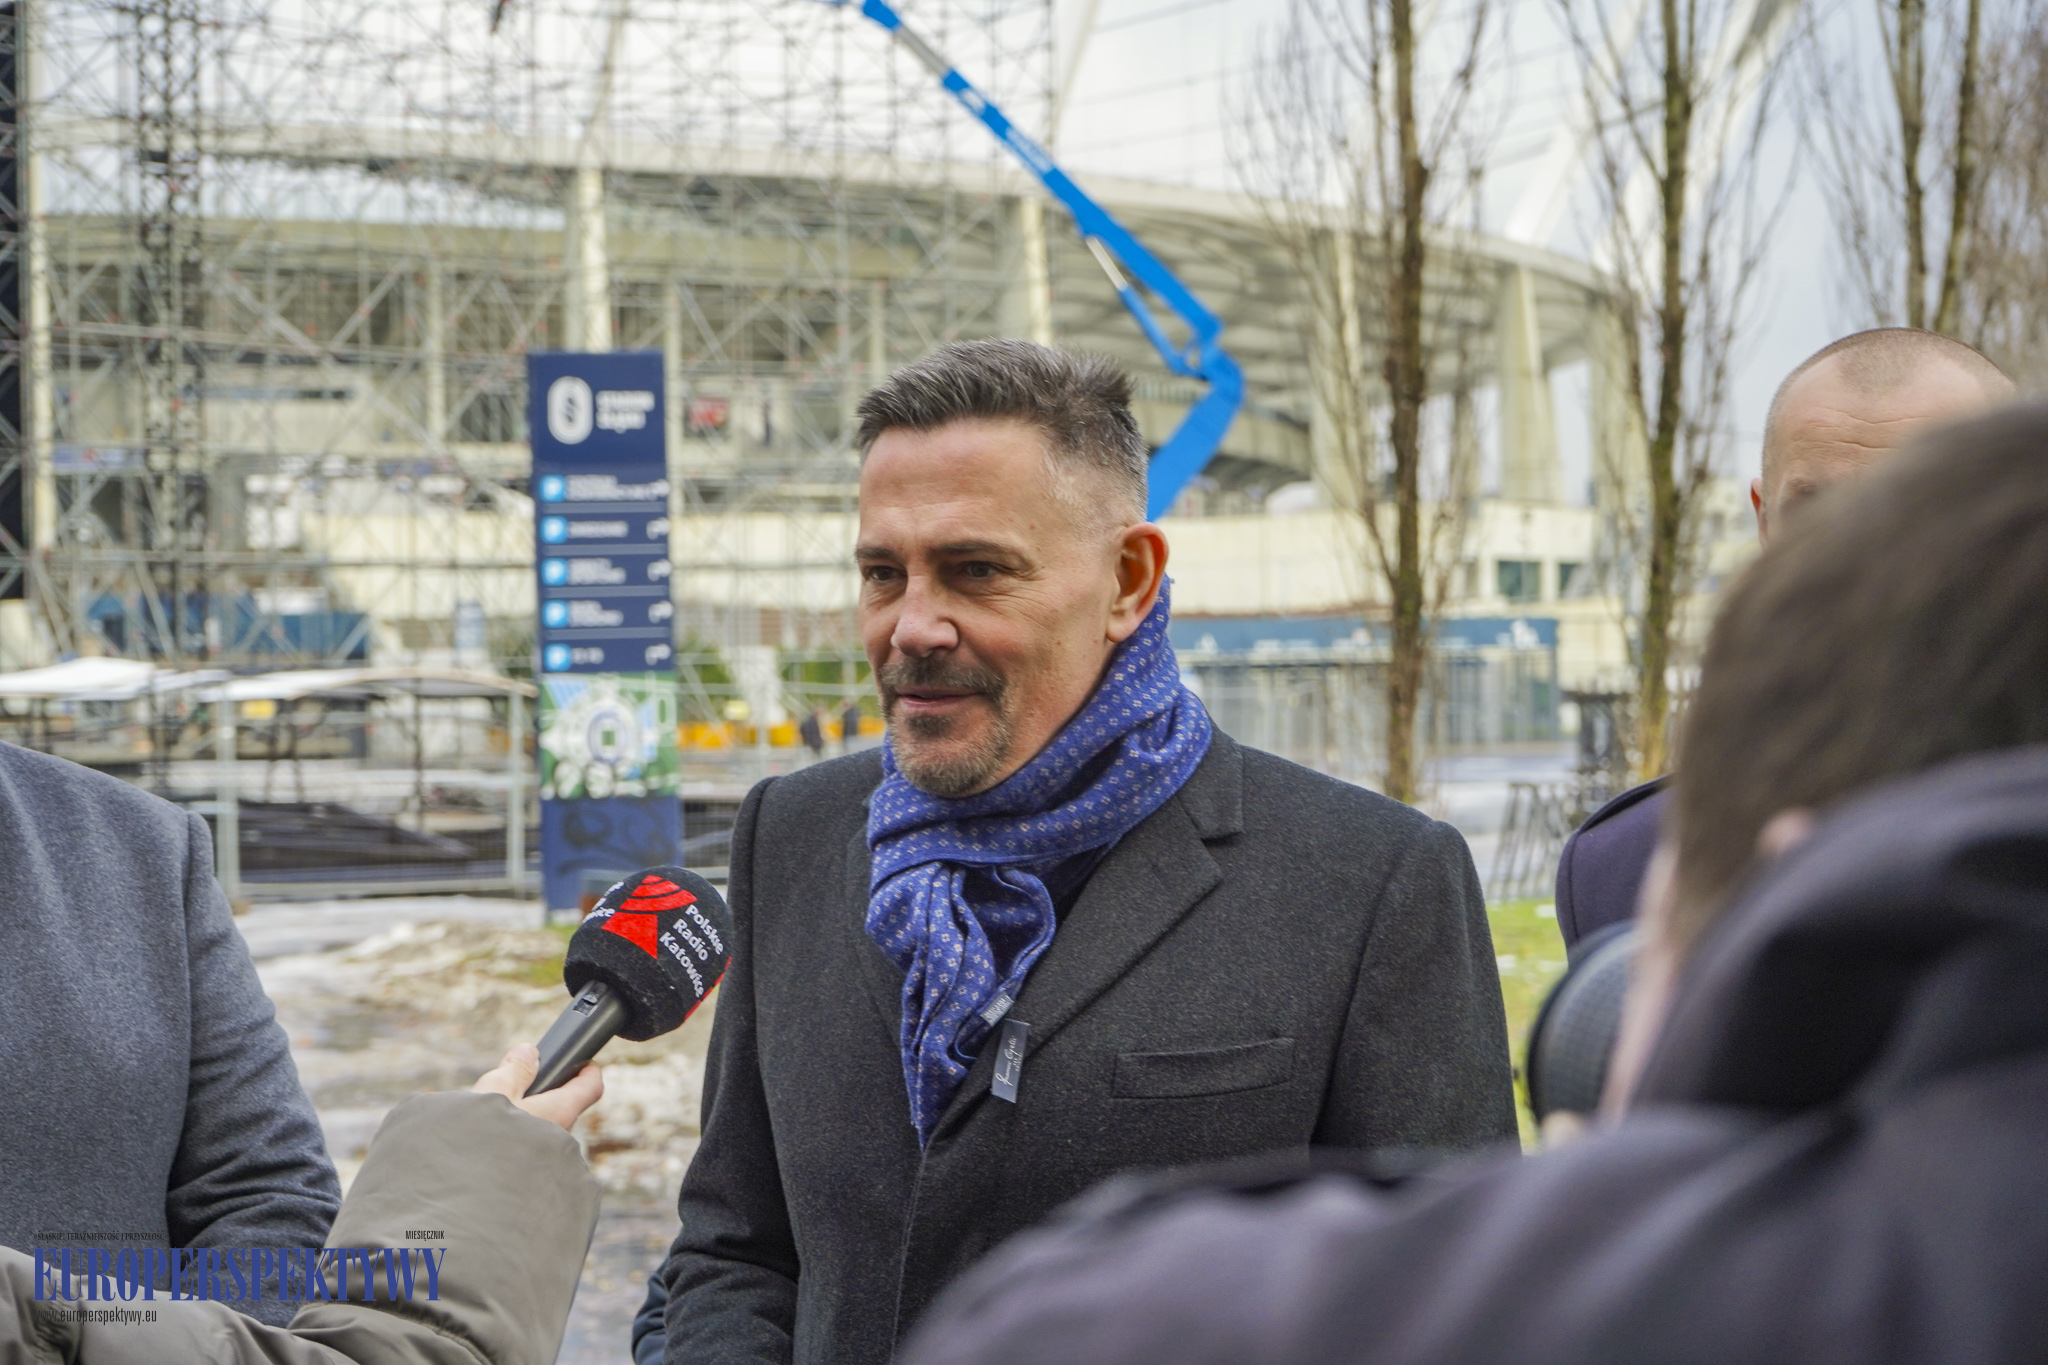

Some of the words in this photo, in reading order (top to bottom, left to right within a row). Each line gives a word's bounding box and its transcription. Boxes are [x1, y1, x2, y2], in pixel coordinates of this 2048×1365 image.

[672, 918, 709, 962] Radio
[685, 904, 724, 955] Polskie
[659, 932, 704, 998] Katowice
